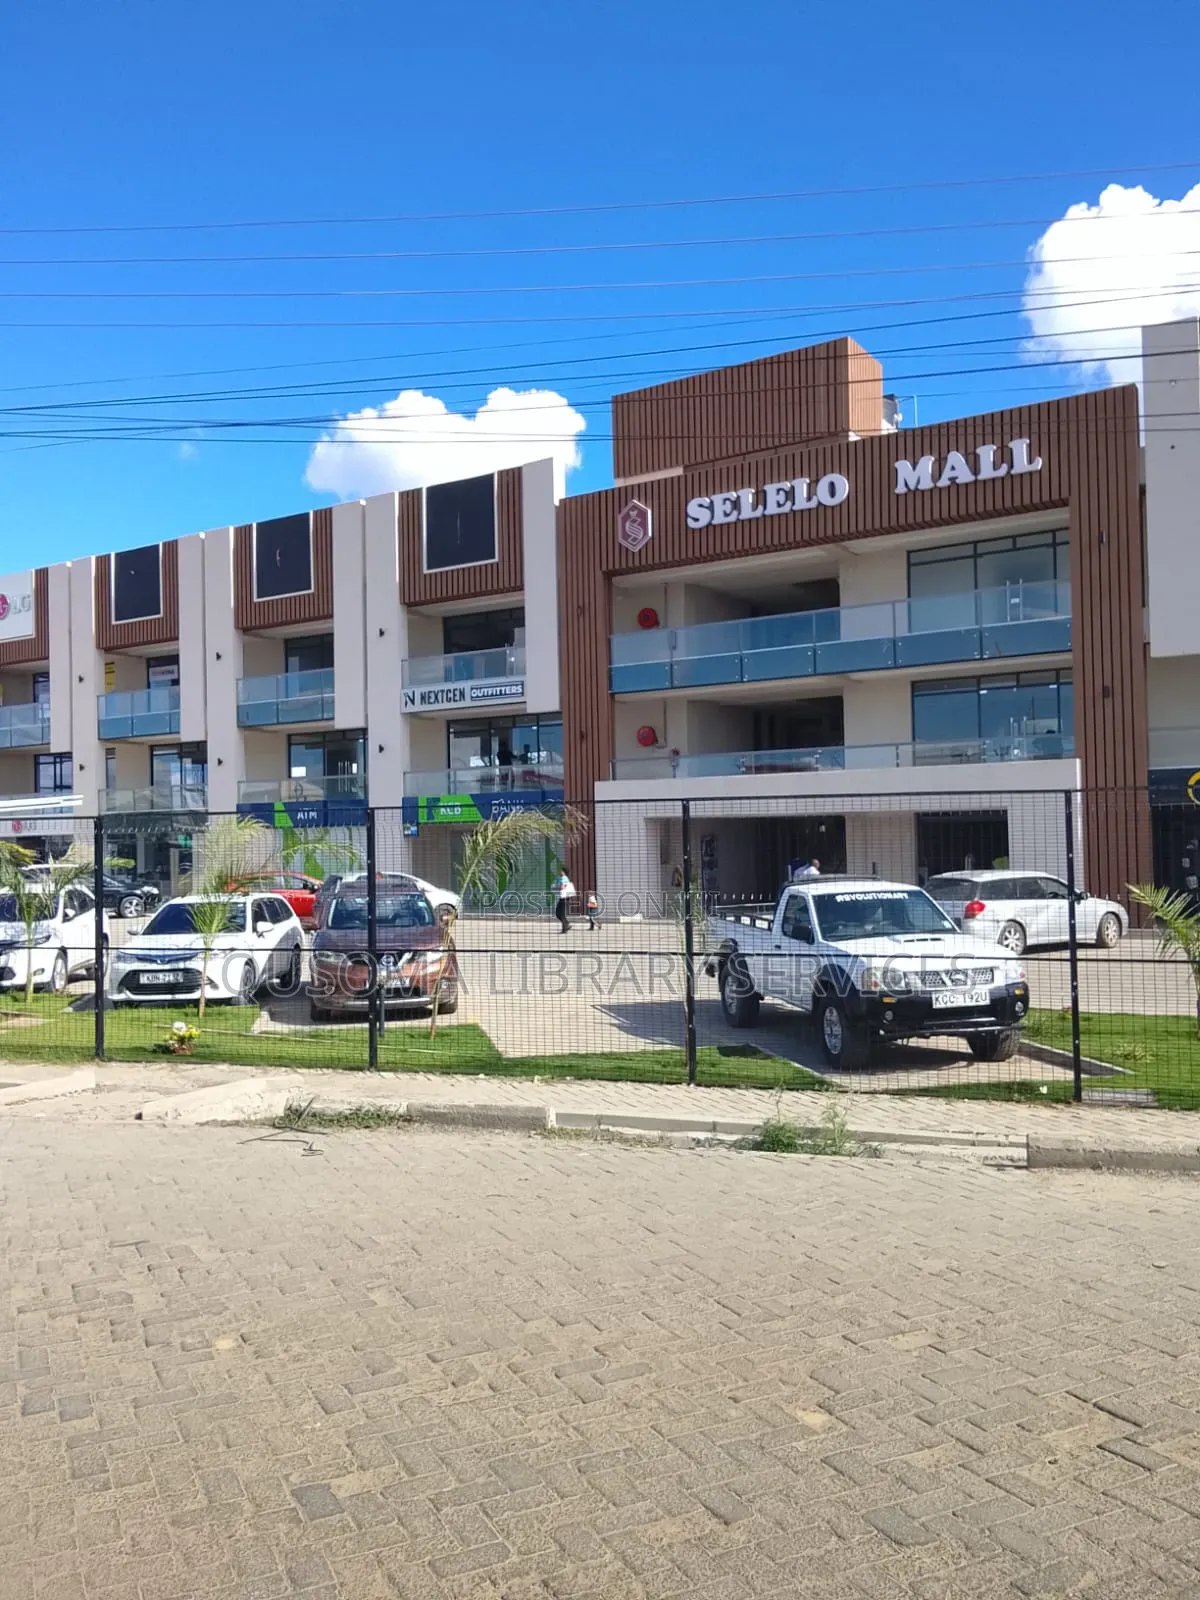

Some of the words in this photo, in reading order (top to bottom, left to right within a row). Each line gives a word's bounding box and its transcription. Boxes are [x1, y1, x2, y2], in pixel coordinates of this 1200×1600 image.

[686, 472, 850, 531] SELELO
[893, 438, 1044, 495] MALL
[11, 594, 31, 615] LG
[420, 687, 466, 706] NEXTGEN
[471, 685, 523, 698] OUTFITTERS
[297, 807, 318, 820] ATM
